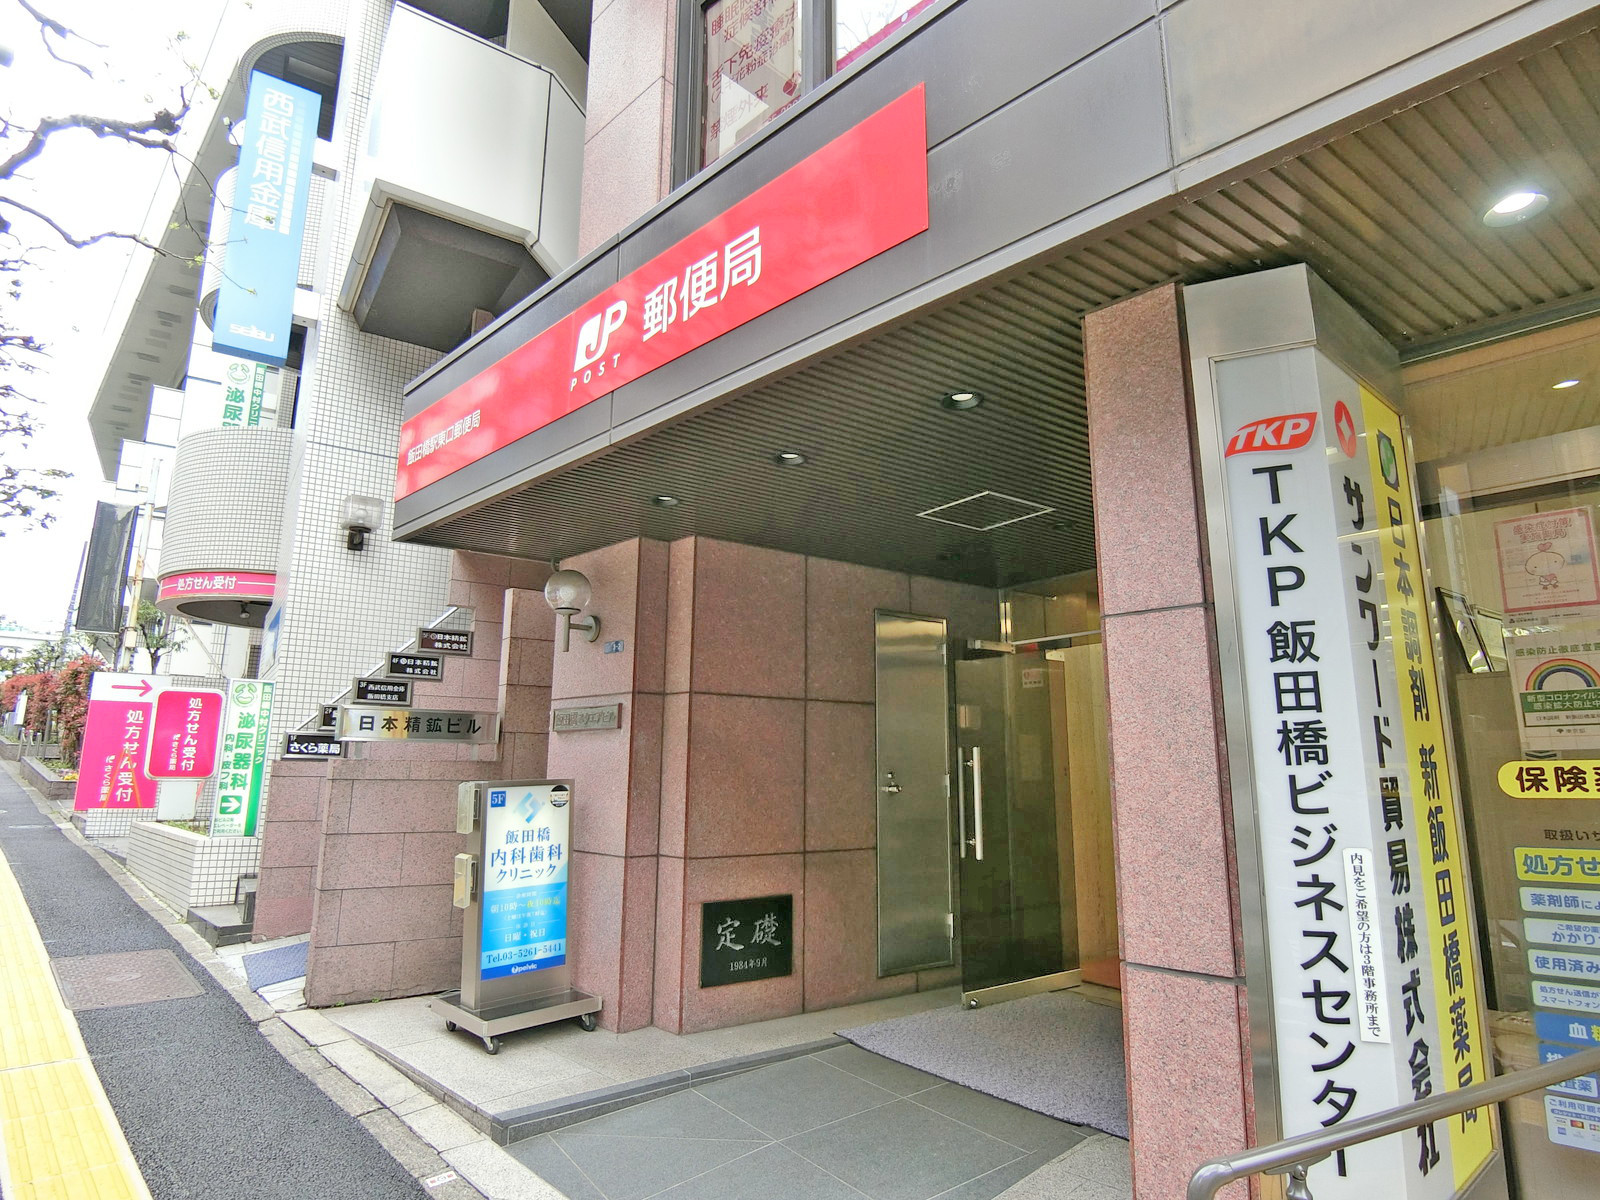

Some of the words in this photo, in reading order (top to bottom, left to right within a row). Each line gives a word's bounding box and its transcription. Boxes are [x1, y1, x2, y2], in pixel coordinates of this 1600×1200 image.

[243, 87, 294, 232] 西武信用金庫
[642, 226, 763, 342] 郵便局
[570, 353, 622, 391] POST
[222, 386, 245, 426] 泌尿
[406, 409, 481, 466] 飯田橋駅東口郵便局
[1234, 418, 1312, 451] TKP
[176, 575, 237, 592] 処方せん受付
[360, 680, 368, 688] 3F
[180, 697, 203, 772] 処方せん受付
[359, 716, 482, 736] 日本精鉱ビル
[115, 709, 144, 802] 処方せん受付
[219, 733, 235, 791] 内科・皮フ科
[229, 711, 256, 791] 泌尿器科
[290, 742, 341, 755] さくら薬局
[491, 793, 506, 807] 5F
[1387, 500, 1430, 722] 日本調剤
[1419, 743, 1478, 1134] 新飯田橋薬局
[505, 827, 551, 845] 飯田橋
[1252, 464, 1358, 1177] TKP飯田橋ビジネスセンター
[1343, 476, 1440, 1177] サンワード貿易株式会社
[491, 843, 563, 868] 内科歯科
[496, 863, 557, 884] クリニック
[716, 913, 782, 951] 定礎
[1351, 853, 1381, 1037] 内見をご希望の方は3階事務所まで
[1552, 931, 1600, 945] かかり
[1535, 955, 1600, 974] 使用済み
[1541, 996, 1600, 1009] スマートフォン
[1554, 1078, 1592, 1094] 査薬
